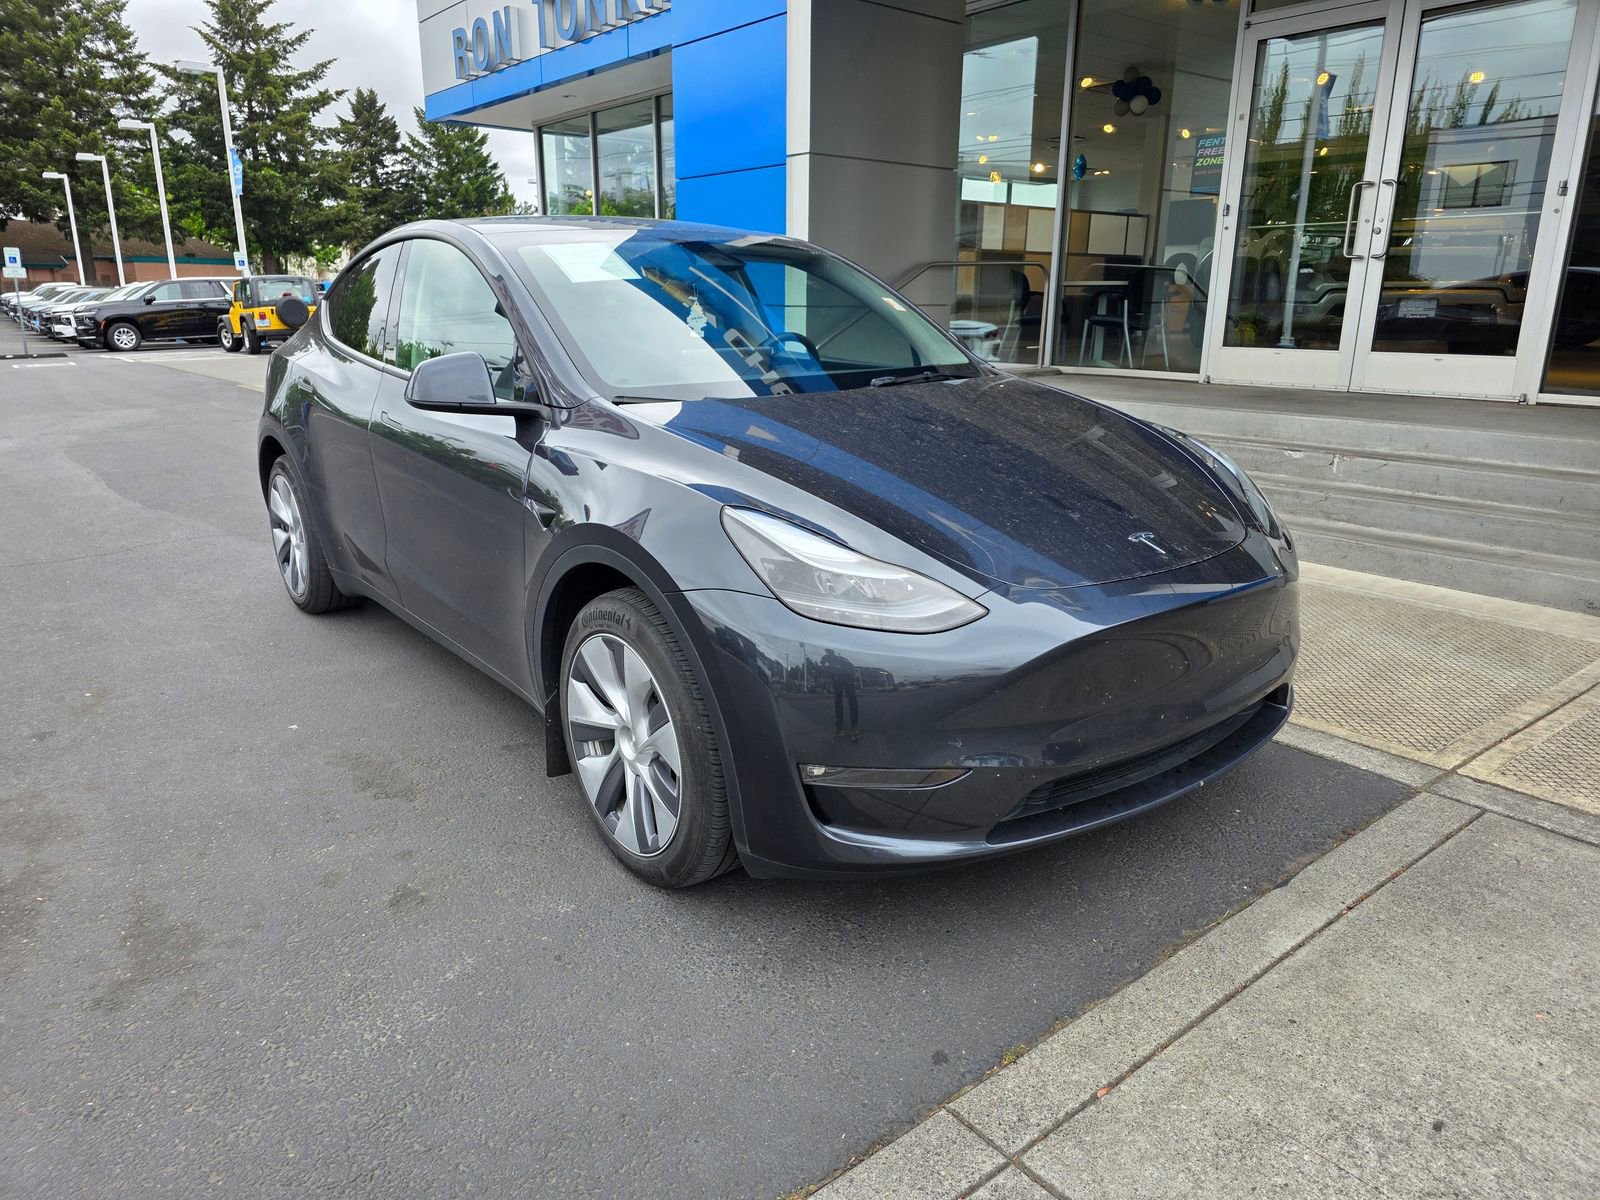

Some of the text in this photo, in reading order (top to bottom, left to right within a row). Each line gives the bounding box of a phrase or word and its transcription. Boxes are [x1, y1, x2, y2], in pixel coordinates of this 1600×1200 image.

[452, 6, 518, 80] RON
[1197, 147, 1225, 157] FREE
[1195, 157, 1224, 167] ZONE
[582, 607, 626, 628] Continental
